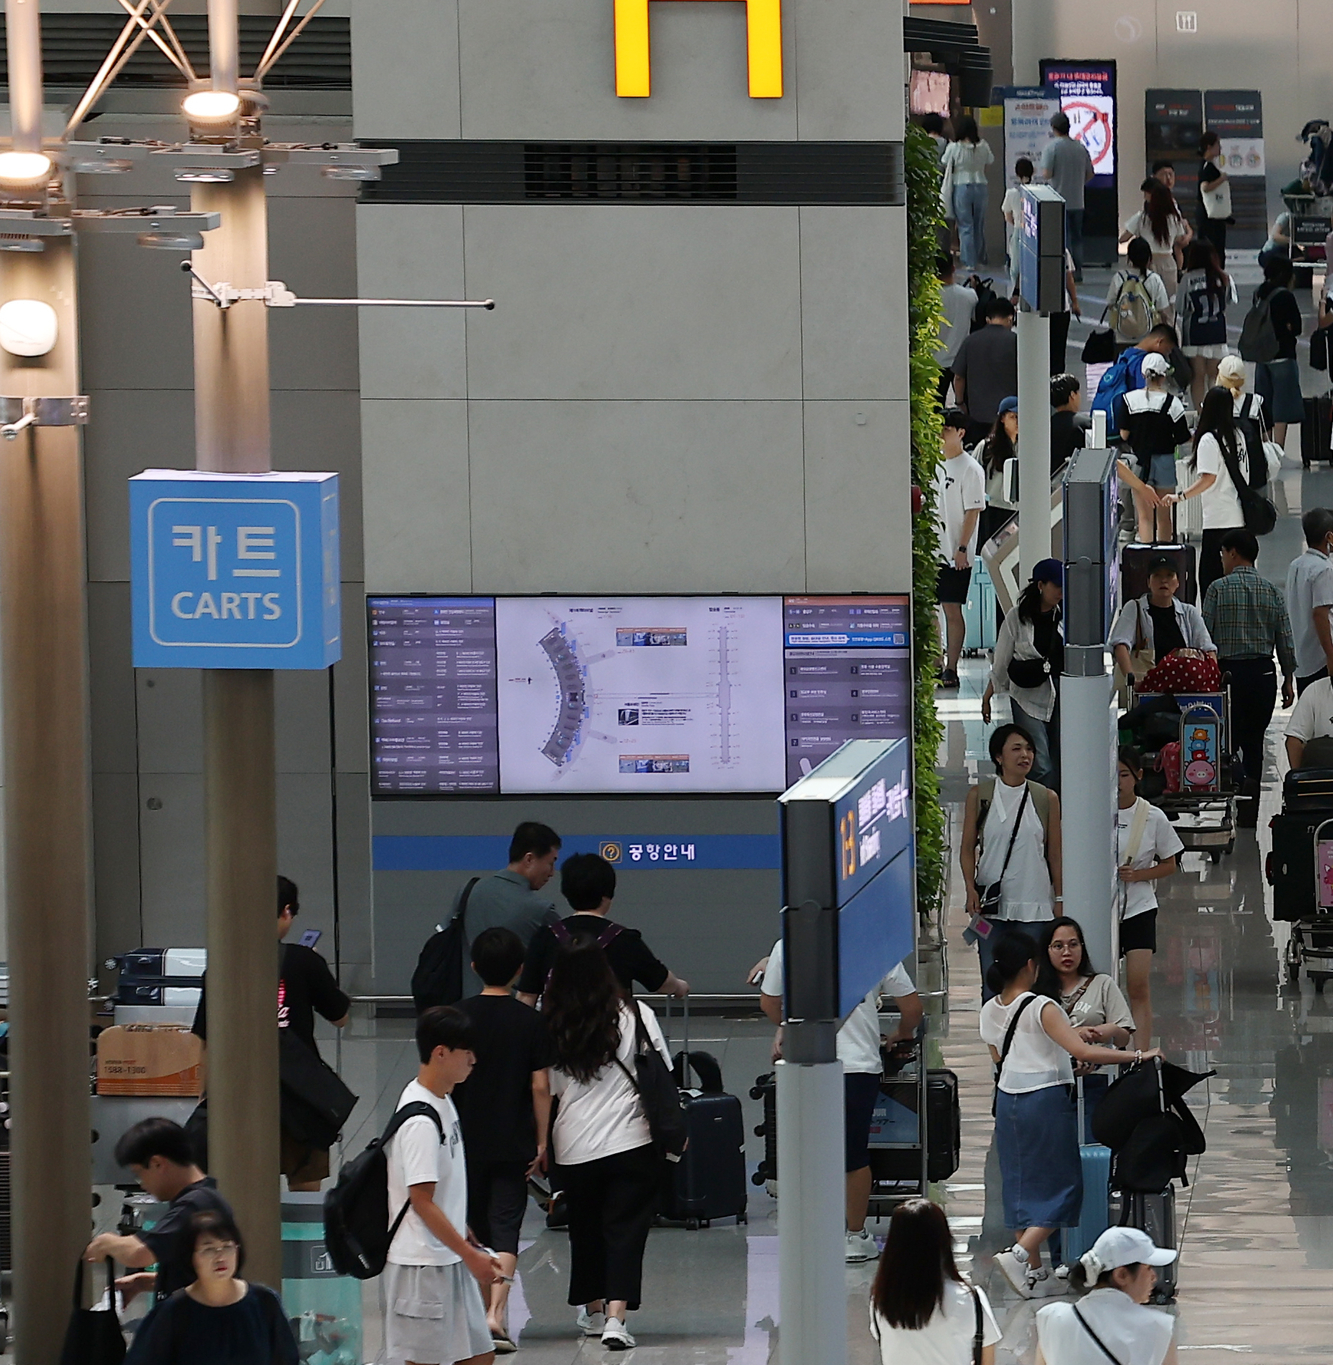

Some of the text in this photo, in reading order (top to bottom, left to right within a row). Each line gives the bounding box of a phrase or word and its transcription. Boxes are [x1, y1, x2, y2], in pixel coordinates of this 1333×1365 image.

[172, 525, 280, 581] 카트
[171, 592, 281, 620] CARTS
[628, 843, 696, 861] 공항안내
